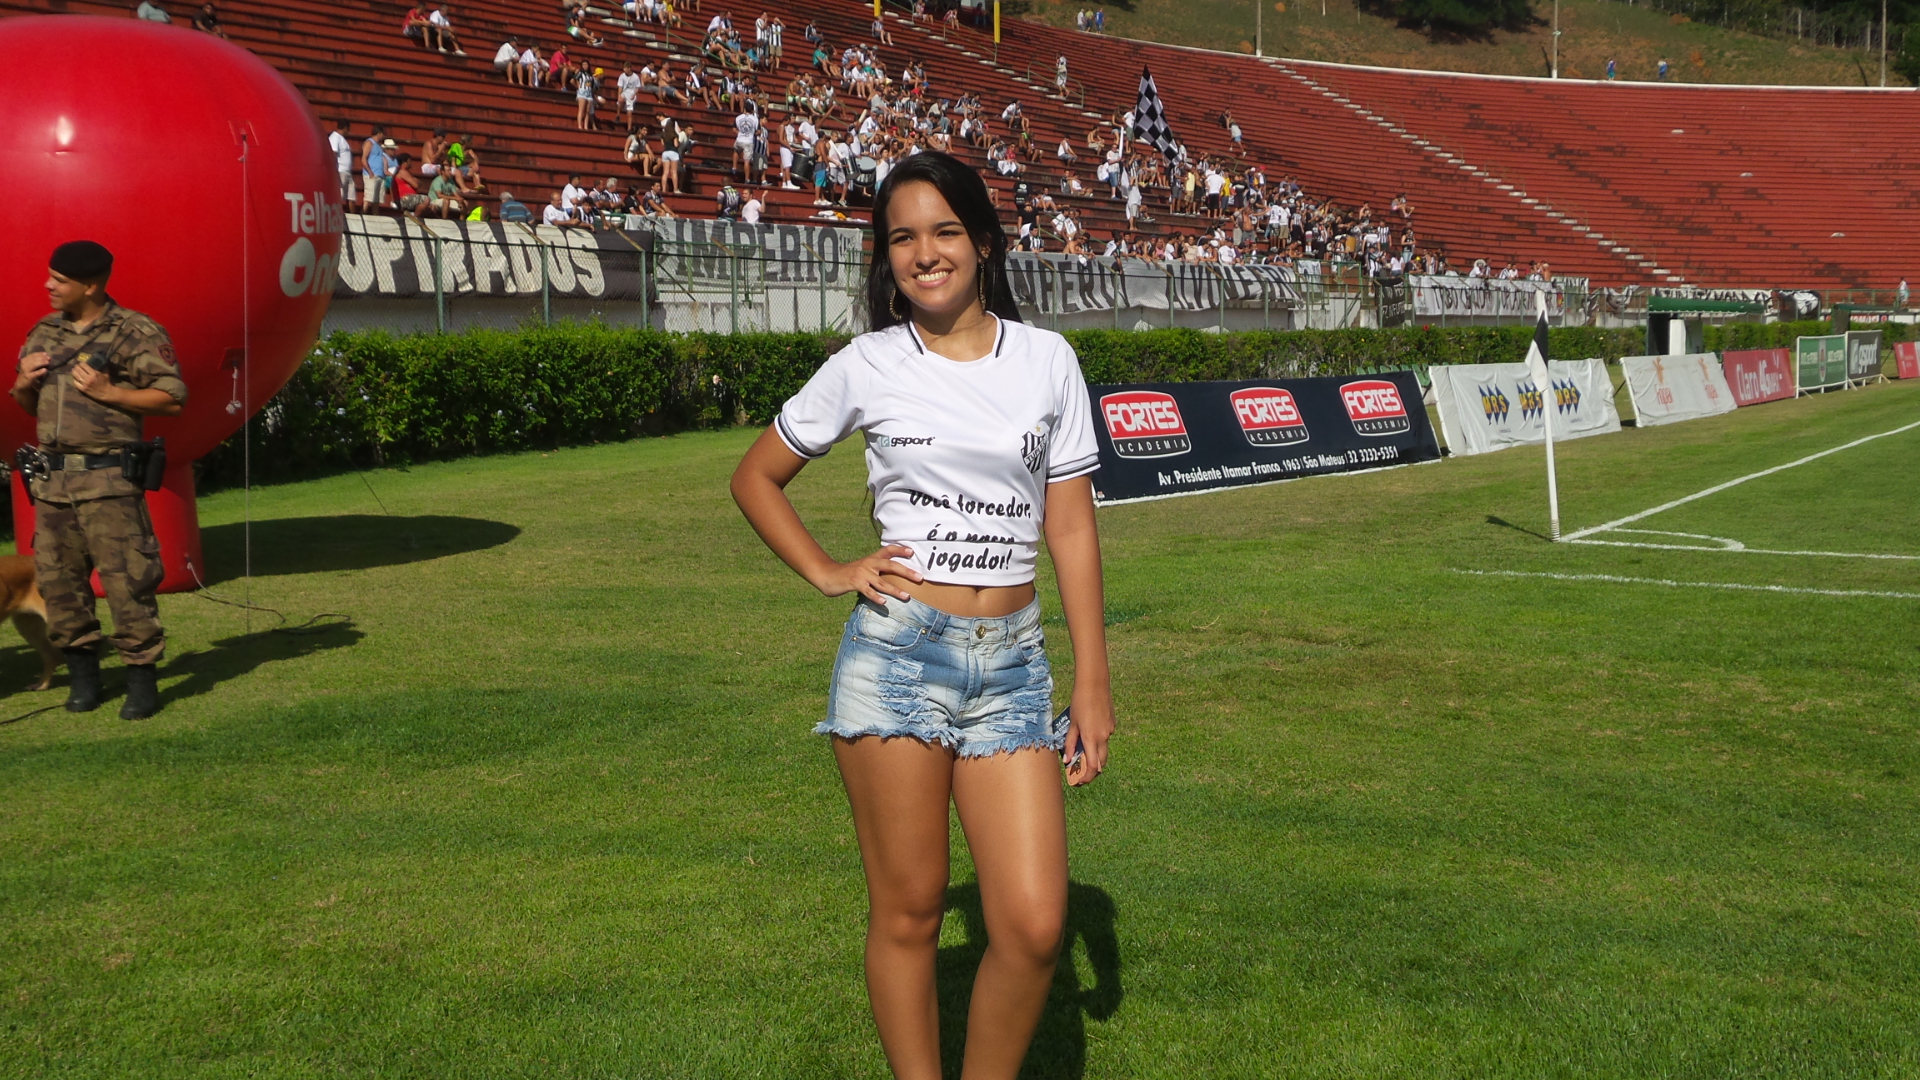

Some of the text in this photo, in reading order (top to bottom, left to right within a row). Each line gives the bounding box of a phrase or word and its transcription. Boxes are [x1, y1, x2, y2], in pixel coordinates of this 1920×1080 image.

[1736, 363, 1760, 401] Claro
[1344, 387, 1401, 415] FORTES
[1481, 393, 1508, 415] MRS
[1518, 390, 1544, 411] MRS
[1554, 386, 1579, 407] MRS
[1105, 401, 1180, 433] FORTES
[1235, 396, 1298, 425] FORTES
[1249, 430, 1306, 443] ACADEMIA
[1357, 419, 1408, 432] ACADEMIA
[890, 436, 933, 447] gsport
[1118, 438, 1188, 453] ACADEMIA
[1158, 471, 1175, 486] Av.
[1173, 466, 1222, 485] Presidente
[1221, 464, 1252, 479] Itamar
[1283, 458, 1301, 472] 1963
[1303, 455, 1319, 469] São
[1318, 453, 1346, 467] Mateus
[1347, 450, 1359, 464] 32
[1359, 445, 1399, 463] 3232-5351
[927, 545, 1013, 573] jogador!
